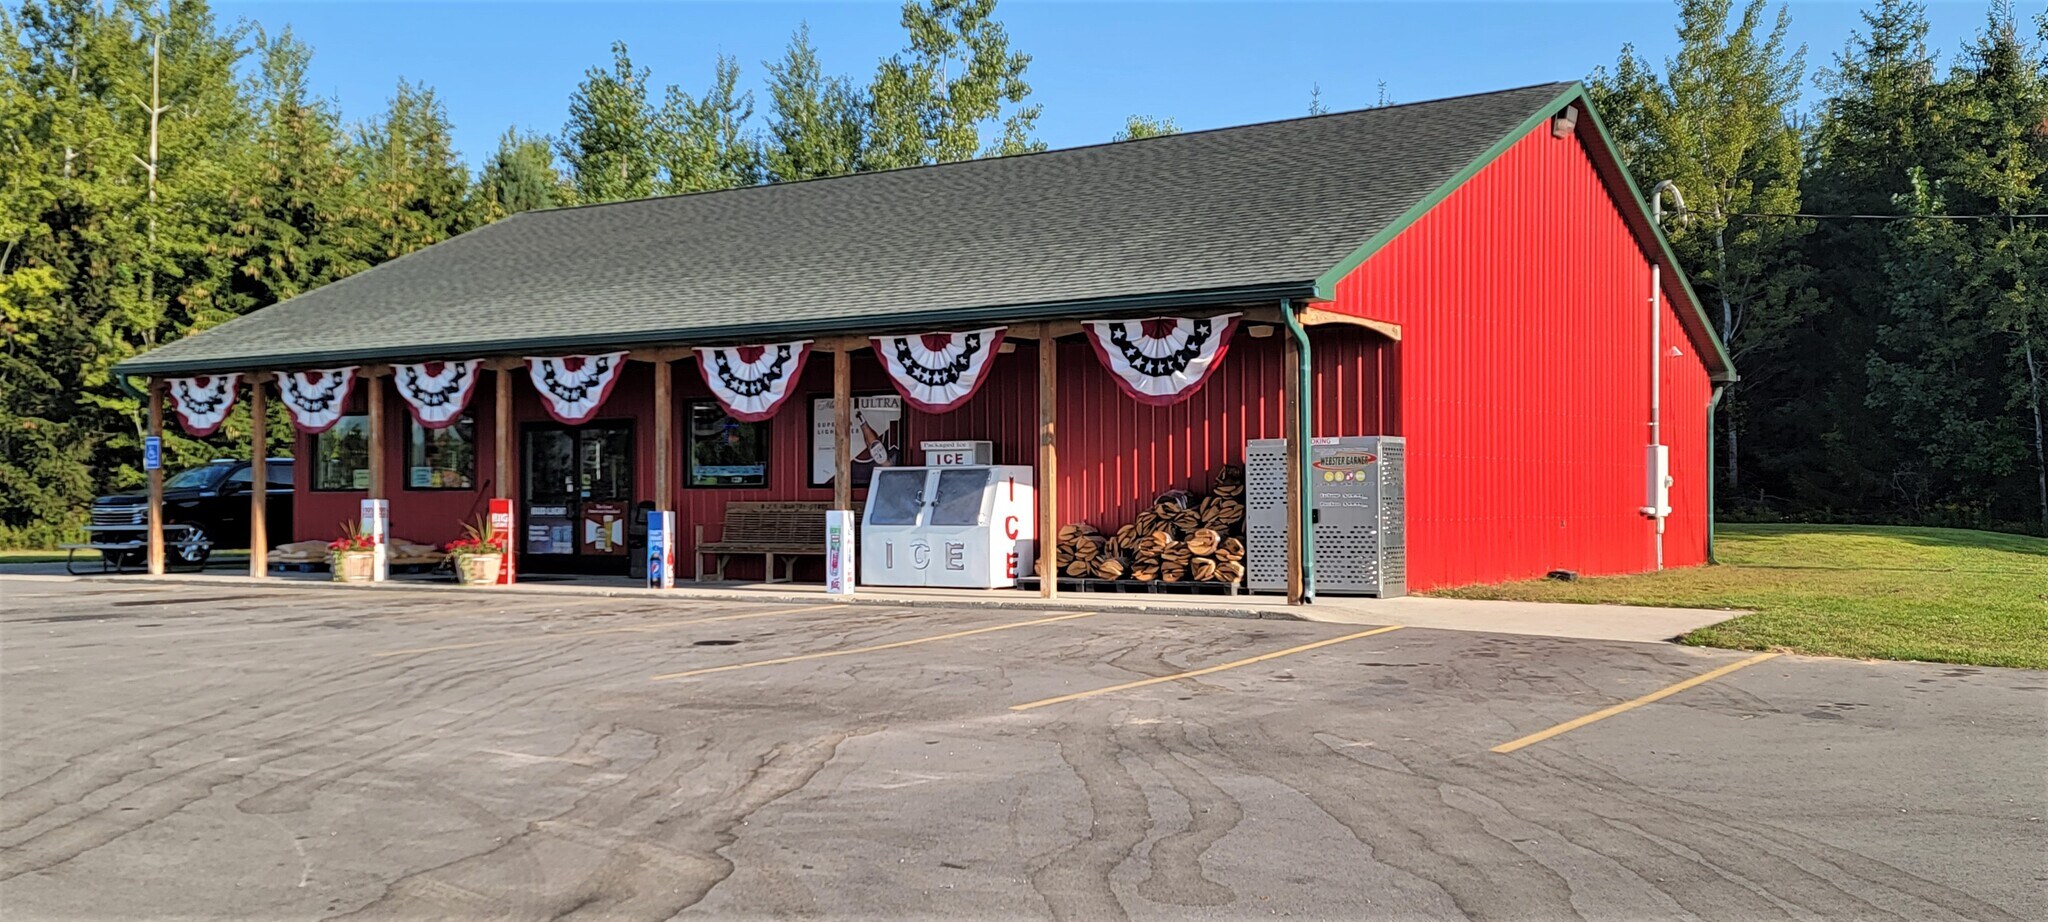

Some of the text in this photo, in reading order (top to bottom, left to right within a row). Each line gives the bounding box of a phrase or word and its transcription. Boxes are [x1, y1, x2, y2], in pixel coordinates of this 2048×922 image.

[861, 397, 899, 408] ULTRA
[936, 453, 964, 465] ICE
[1320, 455, 1369, 466] WEBSTER GARNER
[1005, 473, 1020, 579] ICE
[884, 539, 965, 570] ICE
